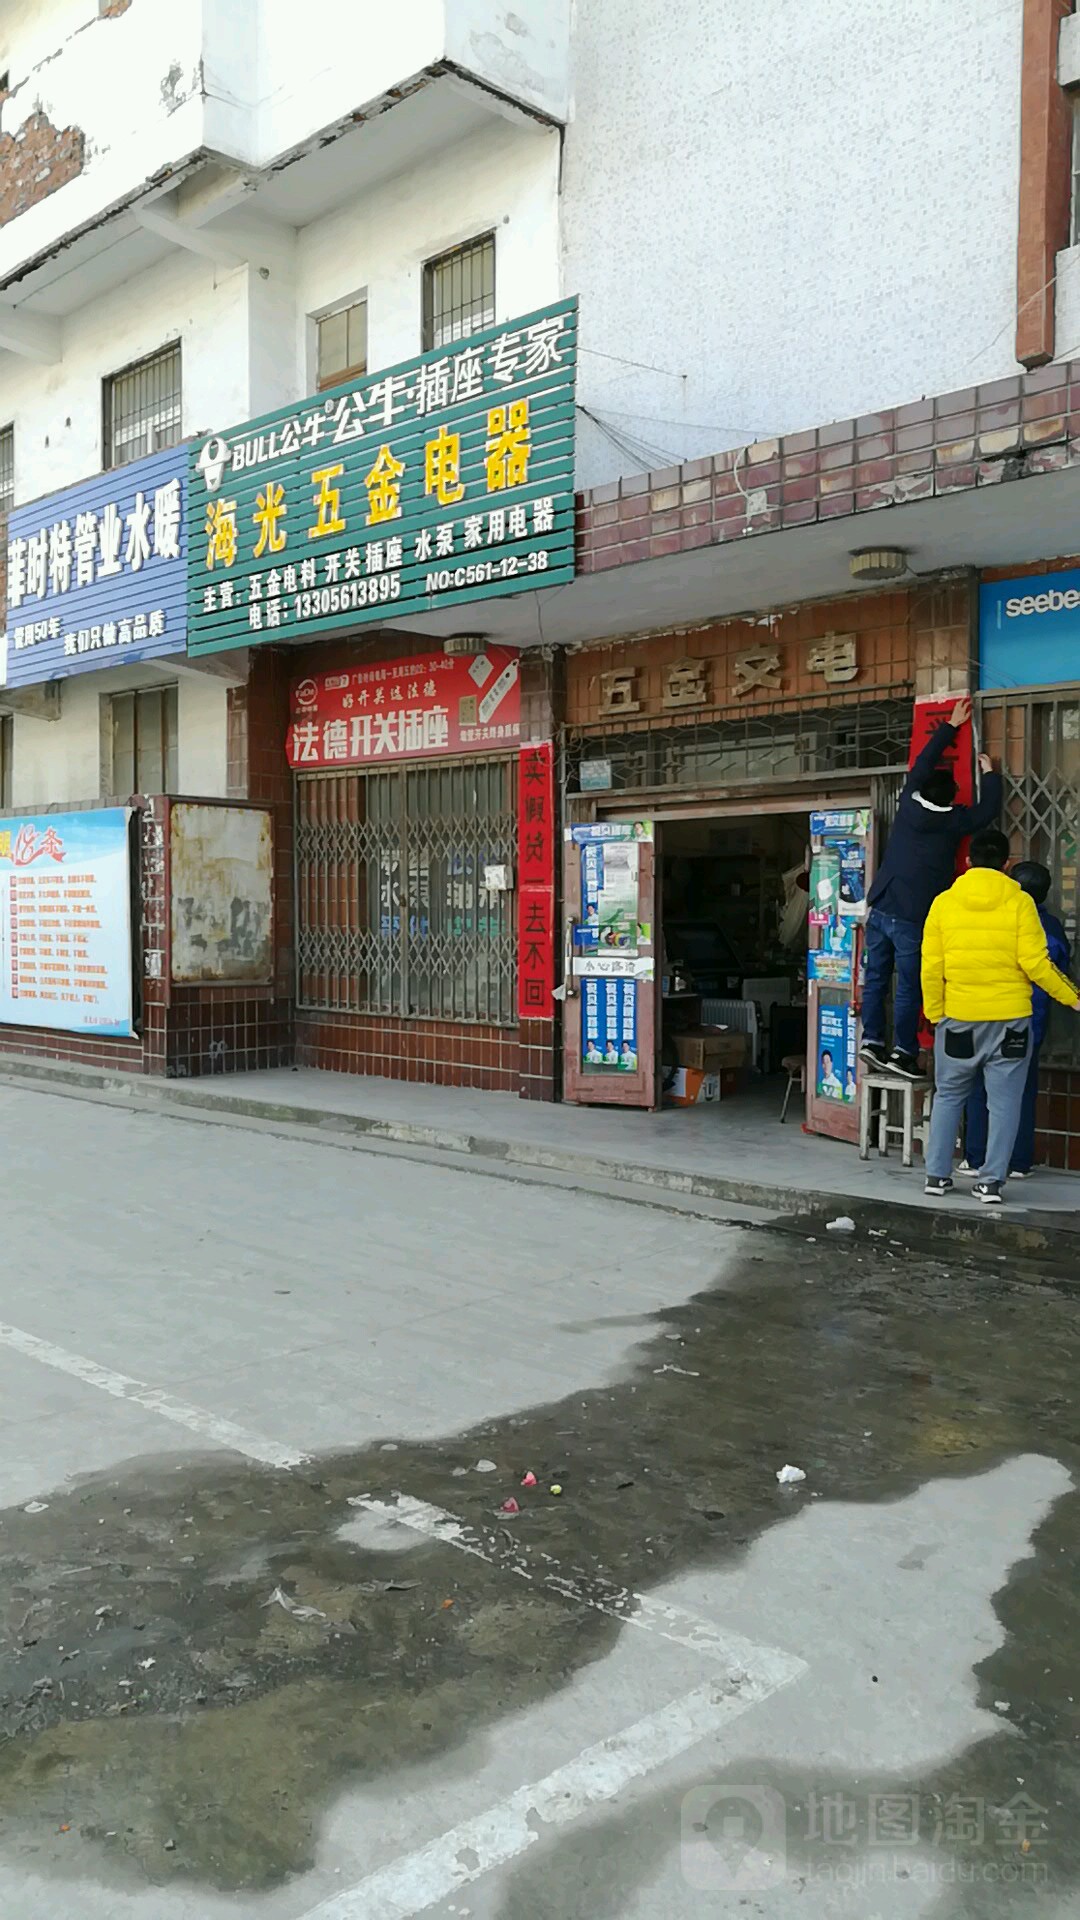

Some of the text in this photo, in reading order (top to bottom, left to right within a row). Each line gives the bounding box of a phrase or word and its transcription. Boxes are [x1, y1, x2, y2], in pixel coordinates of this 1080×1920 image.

[204, 398, 533, 571] 海光五金电器
[414, 521, 455, 562] 水泵
[463, 498, 555, 549] 家用电器
[598, 631, 858, 715] 五金交电
[292, 705, 449, 762] 法德开关插座
